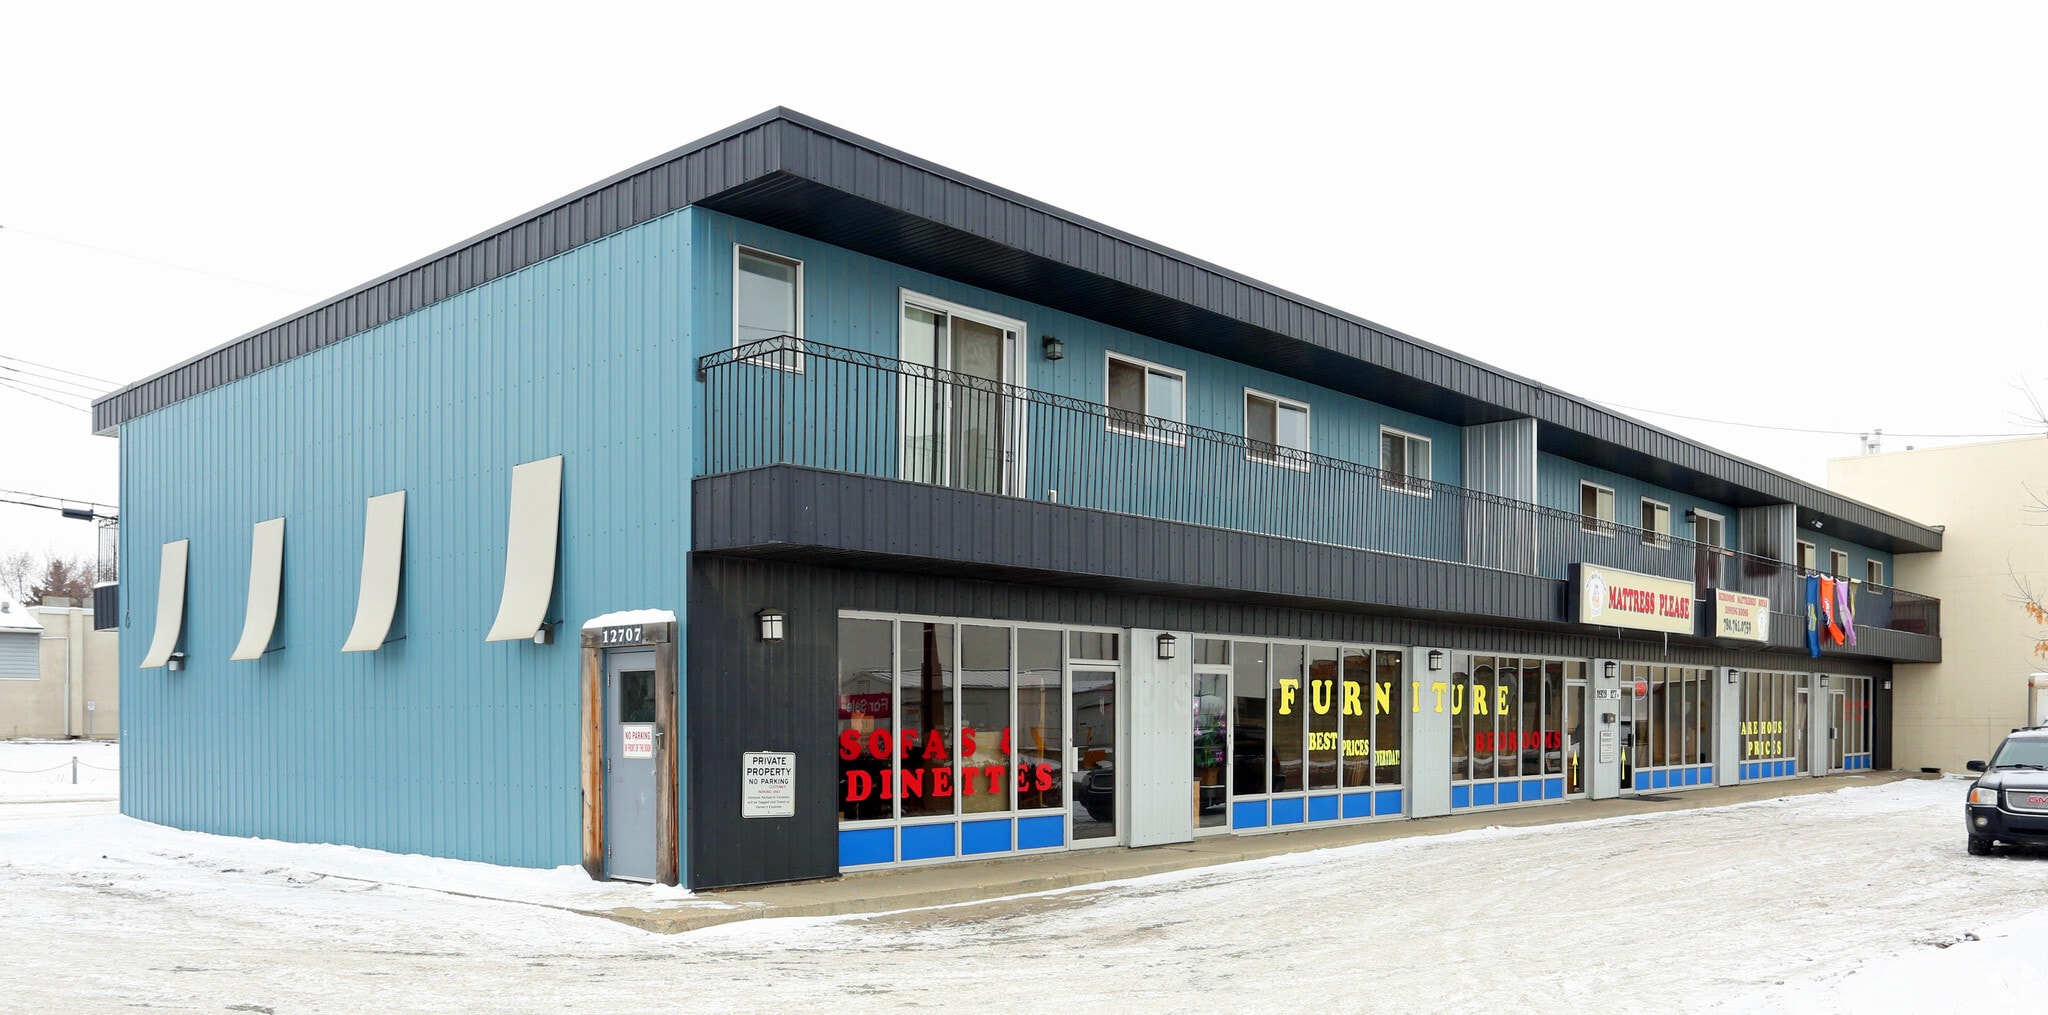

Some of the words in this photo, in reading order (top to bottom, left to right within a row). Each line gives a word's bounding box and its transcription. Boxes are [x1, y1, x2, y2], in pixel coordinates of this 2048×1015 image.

[1608, 585, 1655, 615] MATTRESS
[1659, 593, 1690, 620] PLEASE
[602, 627, 642, 643] 12707
[625, 731, 632, 740] NO
[632, 731, 651, 740] PARKING
[839, 728, 977, 760] SOFAS
[1308, 731, 1338, 751] BEST
[1475, 730, 1562, 752] BEDROOMS
[1341, 739, 1370, 757] PRICES
[752, 756, 787, 766] PRIVATE
[746, 767, 792, 776] PROPERTY
[845, 763, 1053, 801] DINETTES
